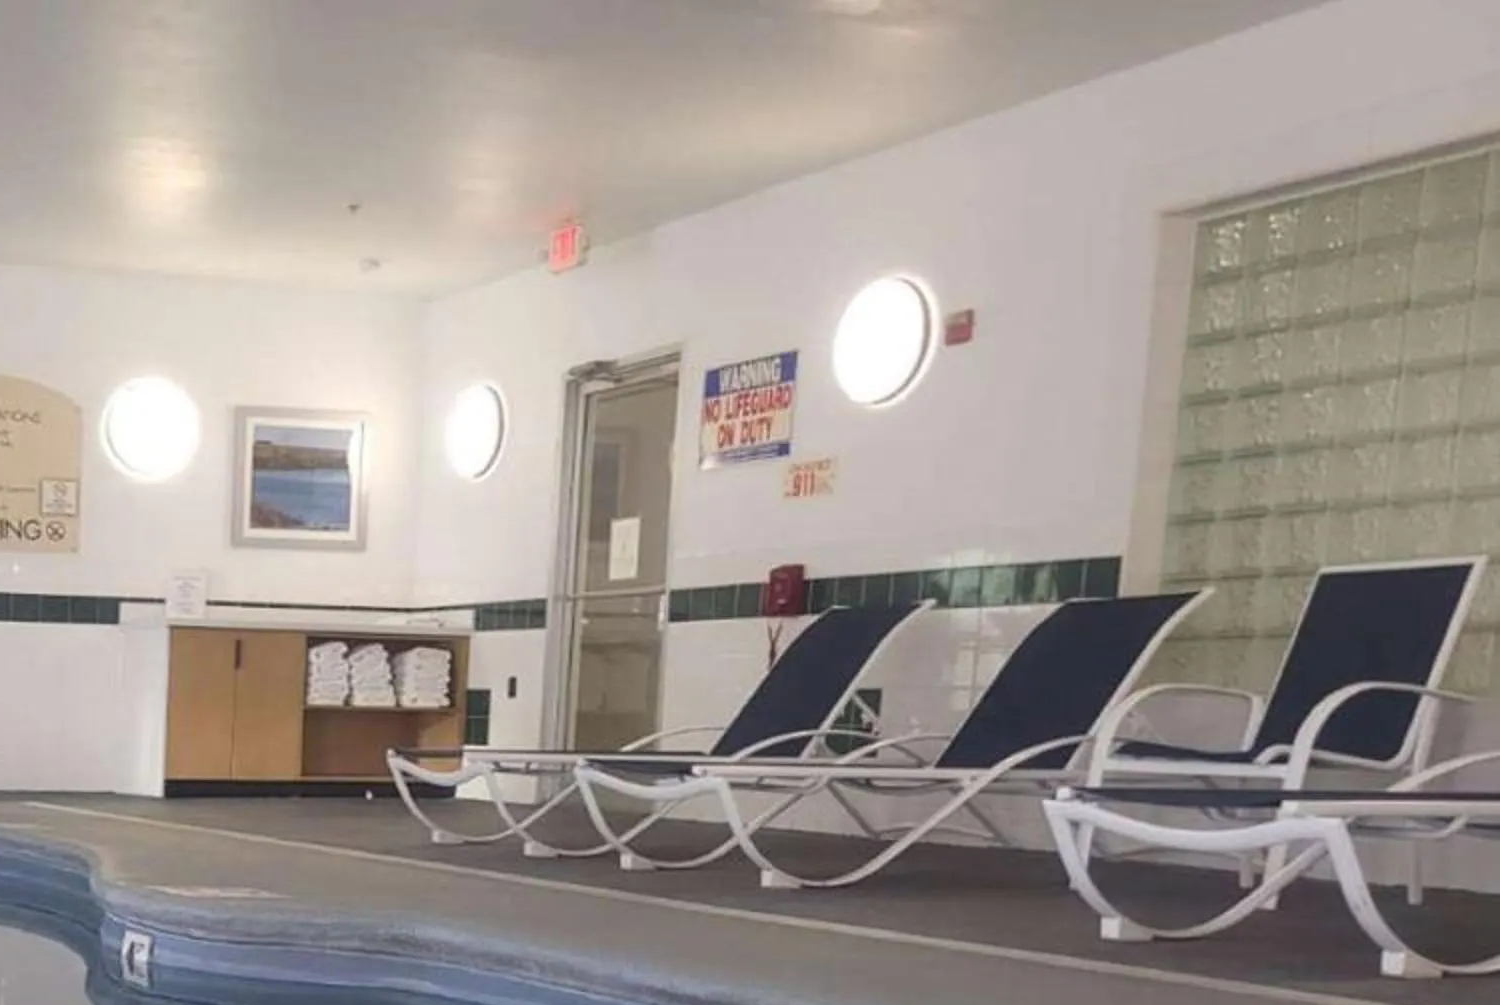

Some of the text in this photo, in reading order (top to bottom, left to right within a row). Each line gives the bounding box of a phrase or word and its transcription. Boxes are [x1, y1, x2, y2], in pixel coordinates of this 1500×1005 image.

[719, 355, 783, 394] WARNING
[704, 384, 793, 424] NO LIFEGUARD
[717, 415, 772, 449] ON DUTY
